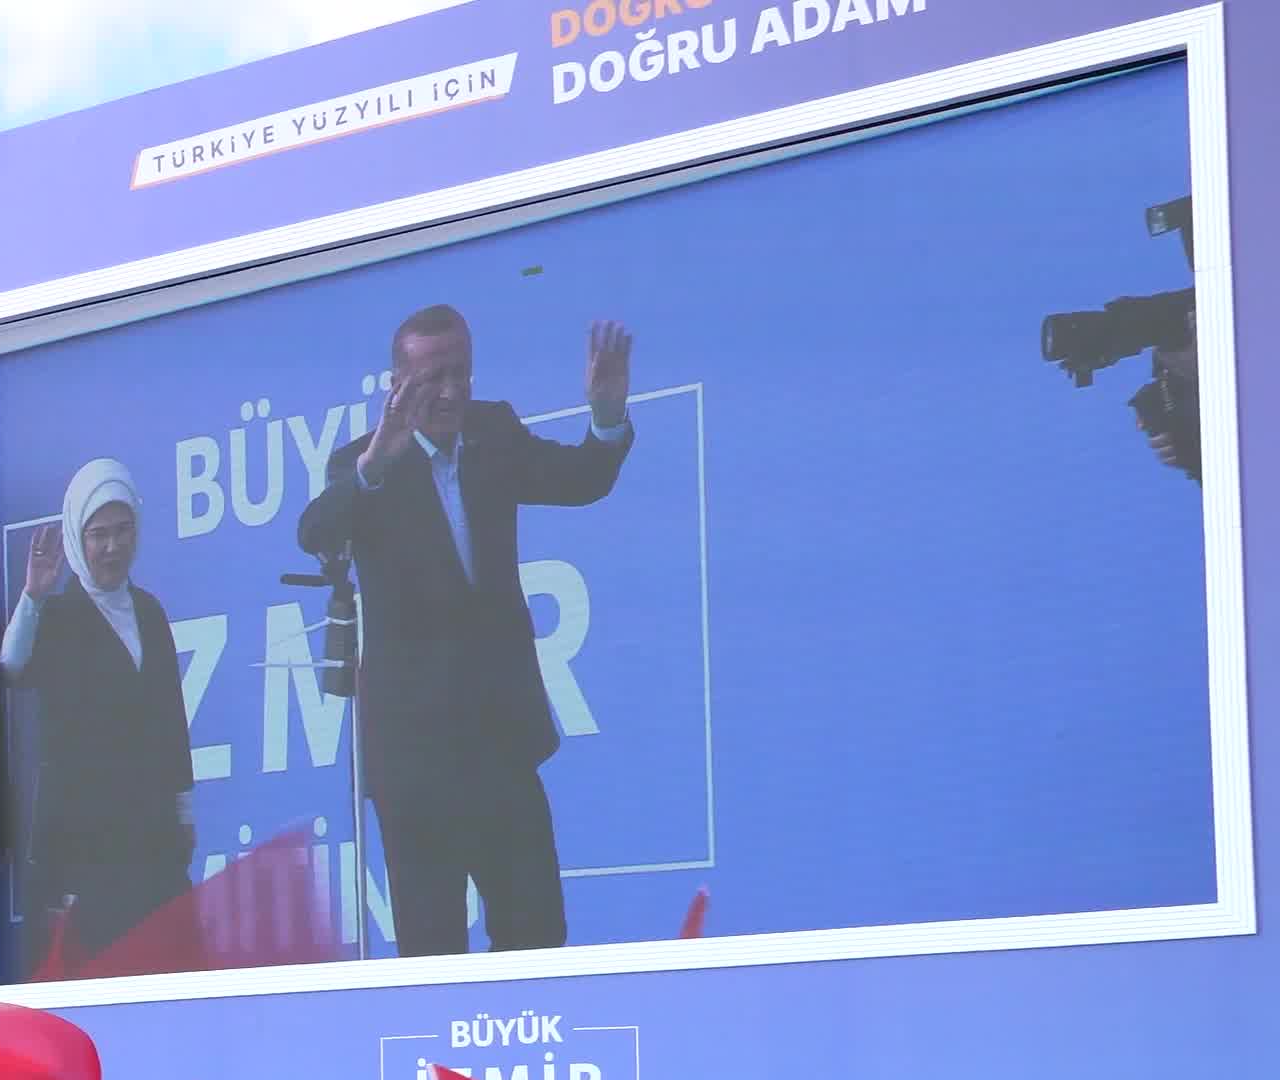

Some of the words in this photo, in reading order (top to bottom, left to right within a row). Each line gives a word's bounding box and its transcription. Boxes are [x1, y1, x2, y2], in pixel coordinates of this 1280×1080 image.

[552, 18, 737, 105] DOĞRU
[152, 124, 275, 173] TÜRKİYE
[292, 88, 413, 136] YÜZYILI
[433, 68, 497, 101] İÇİN
[176, 370, 392, 538] BÜY
[451, 1010, 563, 1048] BÜYÜK
